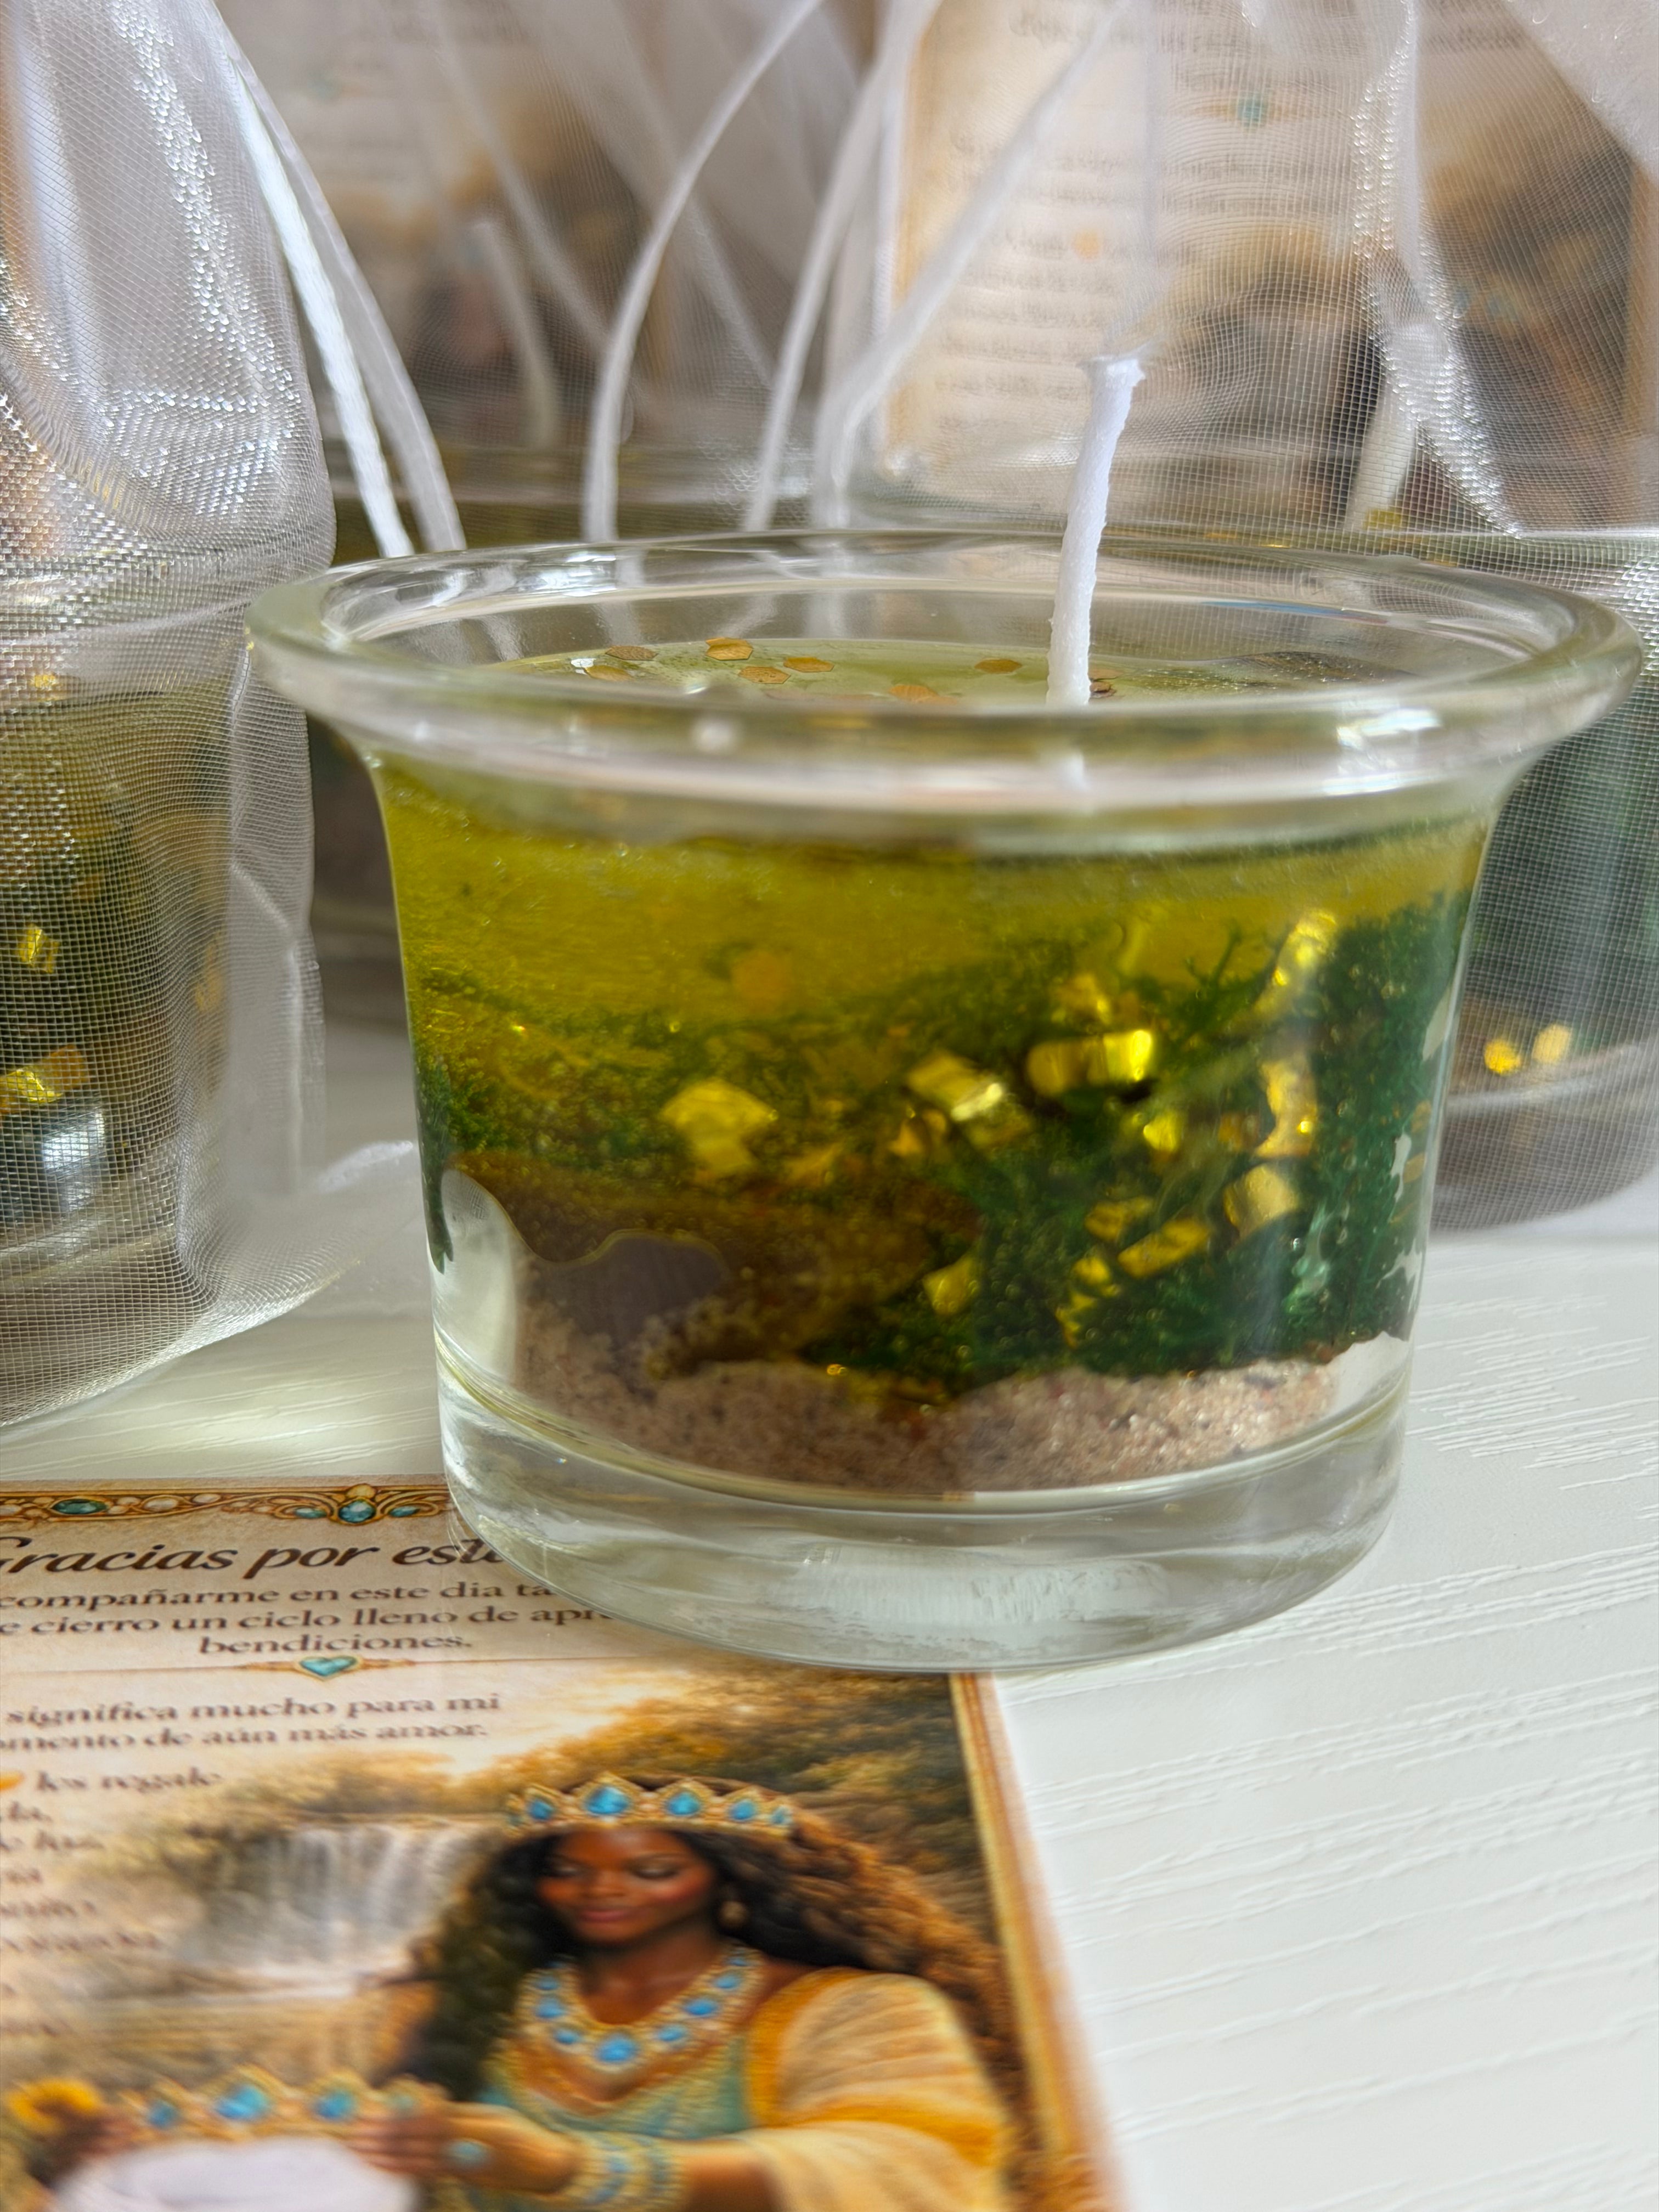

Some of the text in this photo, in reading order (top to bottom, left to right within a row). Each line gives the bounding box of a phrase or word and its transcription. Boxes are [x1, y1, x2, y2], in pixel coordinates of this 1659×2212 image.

[242, 1547, 380, 1579] por
[290, 1589, 339, 1602] en
[349, 1587, 429, 1600] este
[440, 1581, 504, 1598] dia
[31, 1617, 160, 1634] cierro
[172, 1618, 227, 1629] un
[238, 1610, 341, 1628] ciclo
[353, 1607, 458, 1626] lleno
[468, 1605, 519, 1623] de
[199, 1633, 473, 1654] bendiciones.
[7, 1693, 501, 1728] significa mucho para mi
[144, 1727, 193, 1747] de
